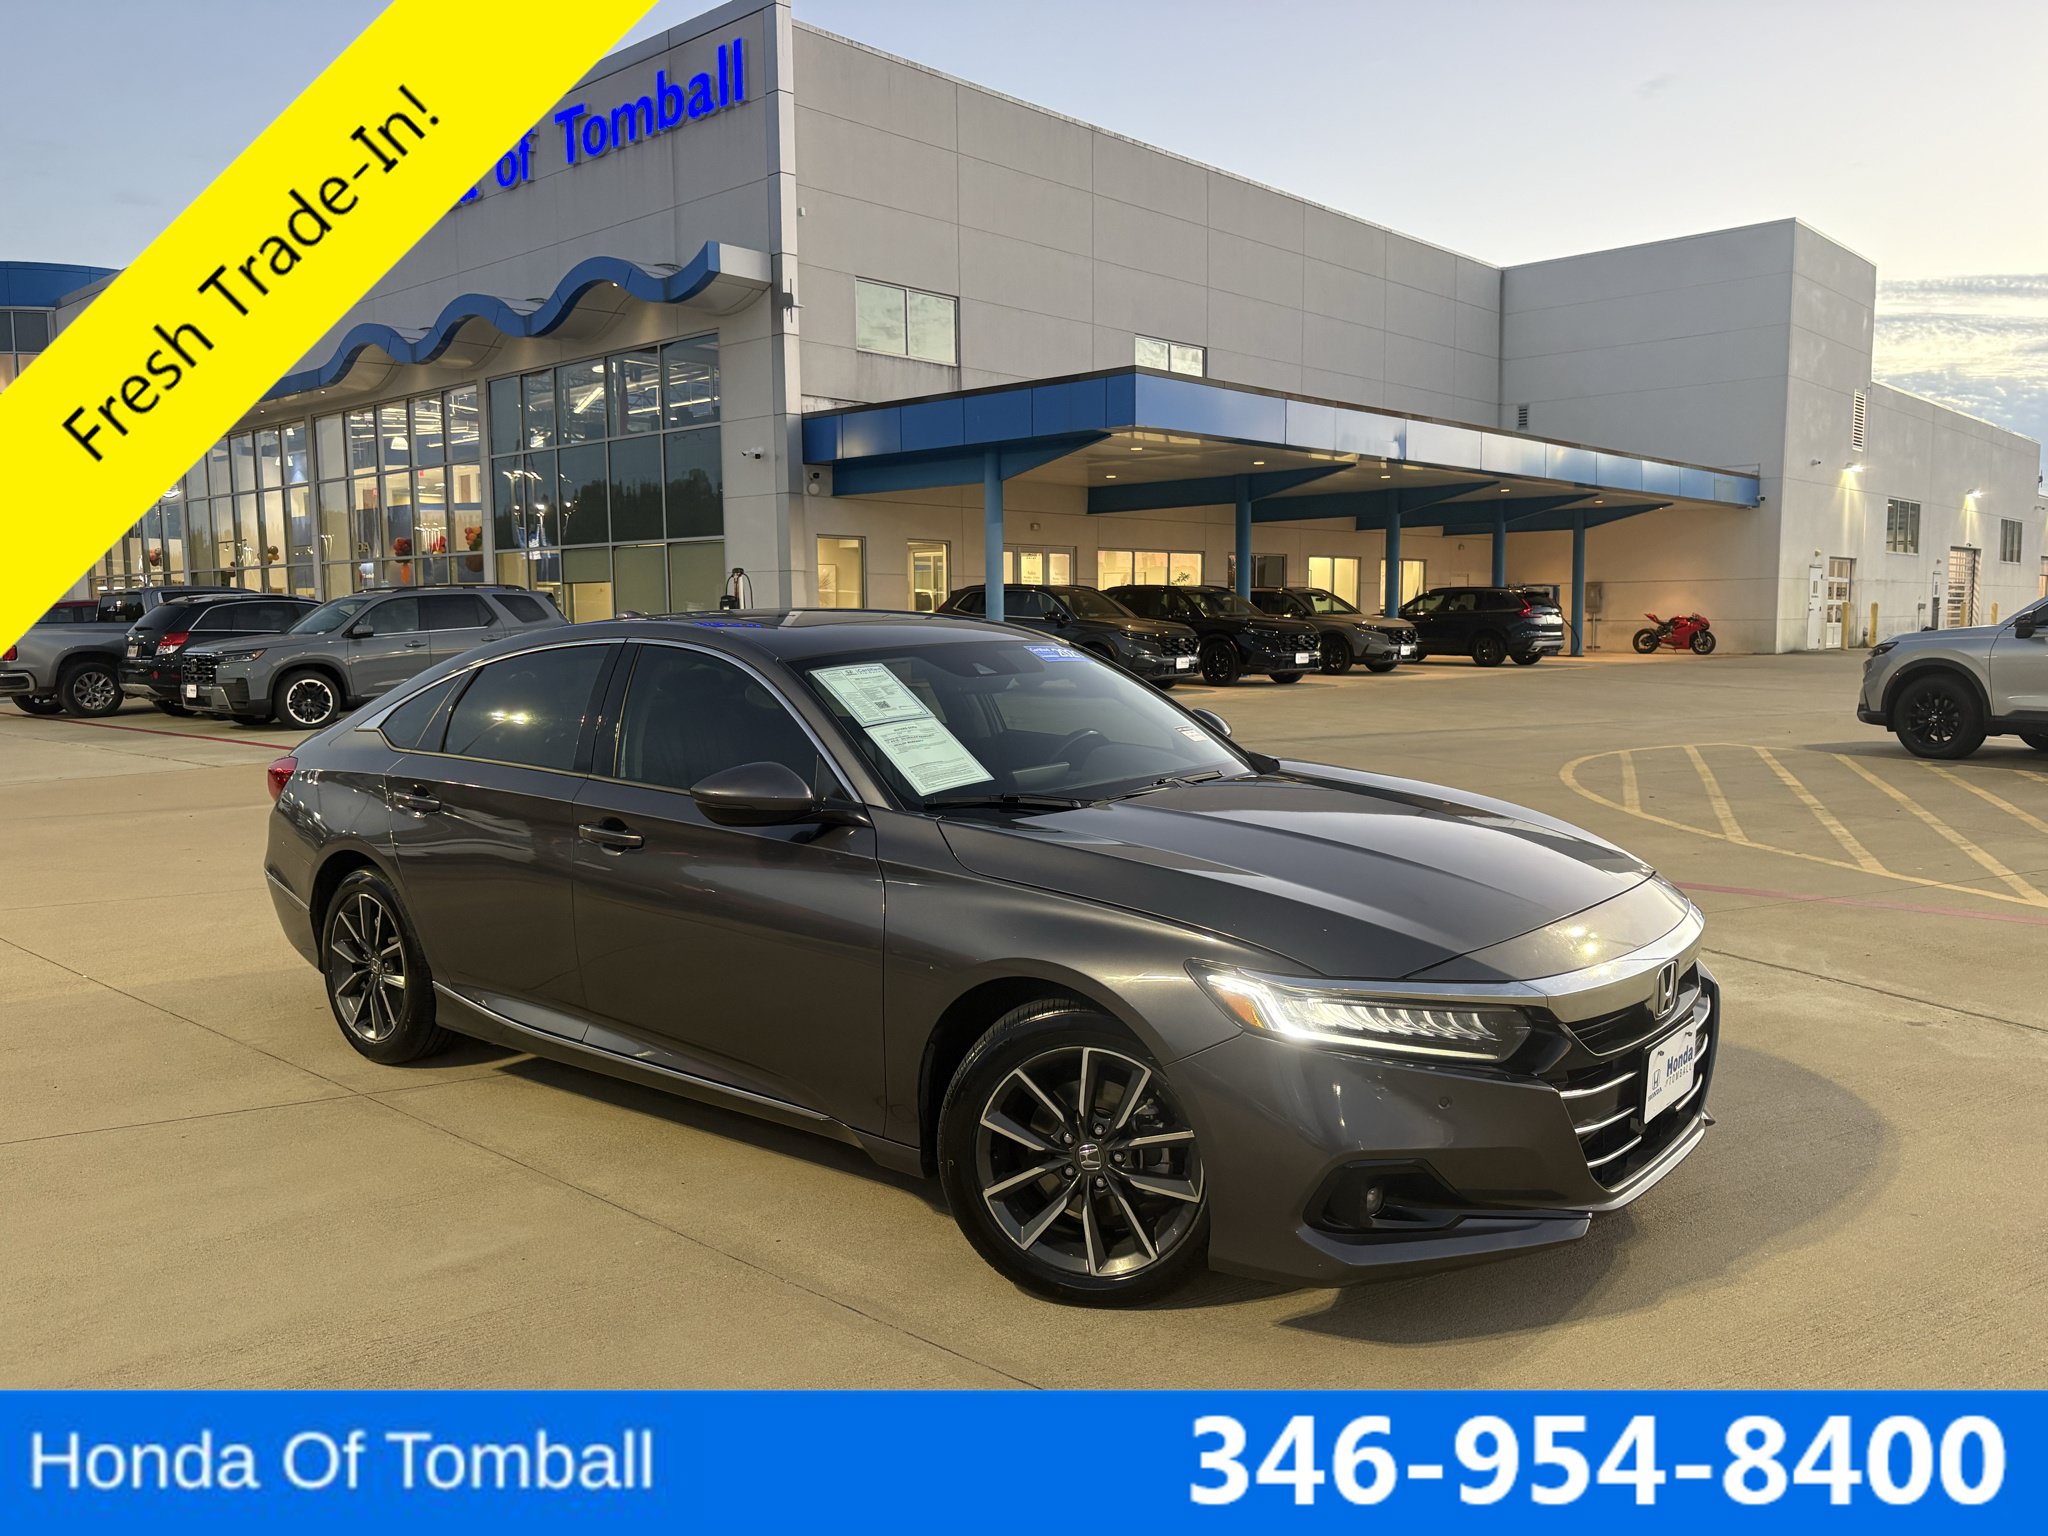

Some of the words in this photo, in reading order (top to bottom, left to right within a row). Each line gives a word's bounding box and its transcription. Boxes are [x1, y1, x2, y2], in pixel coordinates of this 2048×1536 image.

[495, 129, 535, 188] of
[554, 38, 746, 163] Tomball
[1666, 1045, 1694, 1077] Honda
